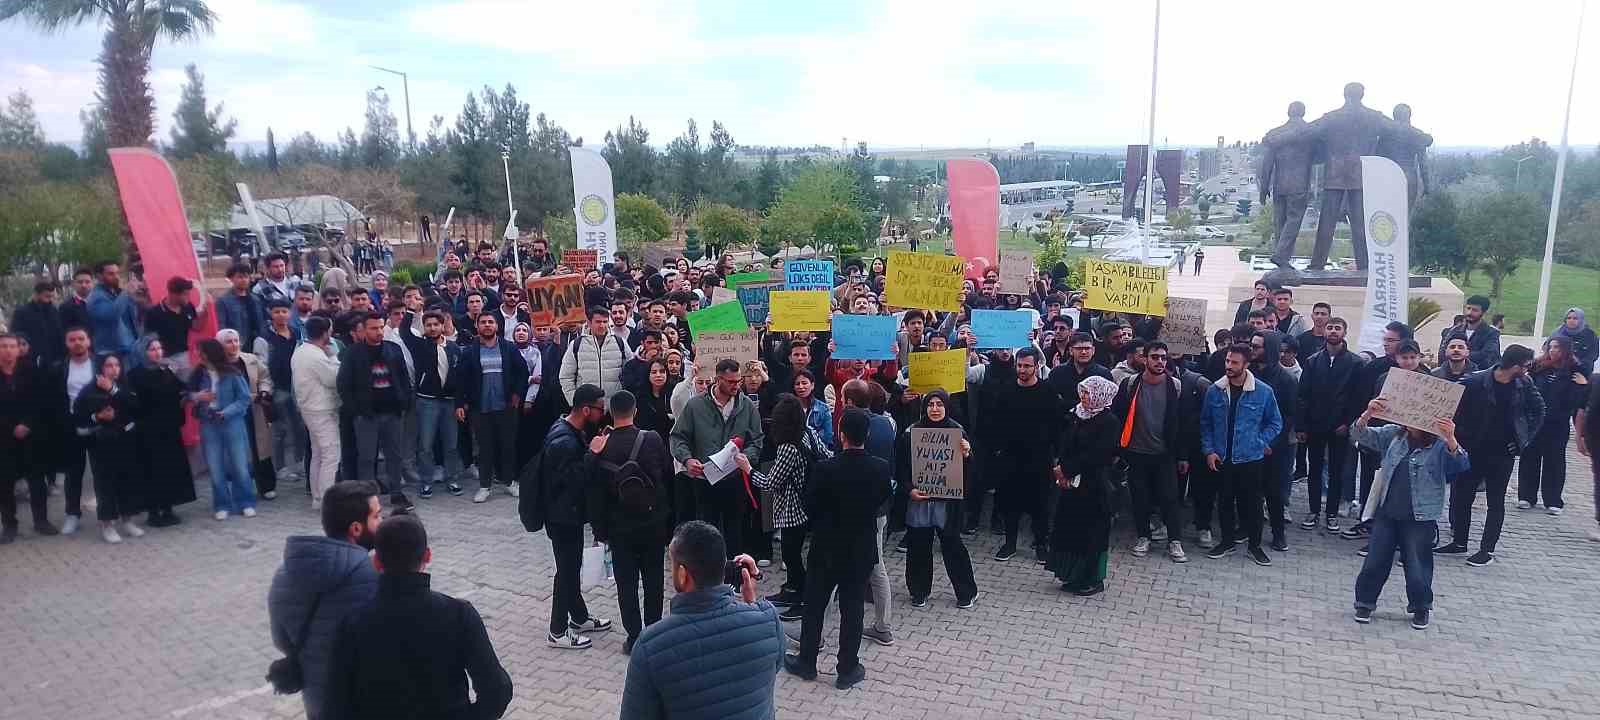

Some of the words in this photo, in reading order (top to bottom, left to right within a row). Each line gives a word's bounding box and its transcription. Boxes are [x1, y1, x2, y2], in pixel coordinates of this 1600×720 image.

[1125, 280, 1157, 294] HAYAT
[1105, 292, 1140, 308] VARDI
[916, 446, 954, 461] YUVASI
[917, 472, 947, 488] ÖLÜM
